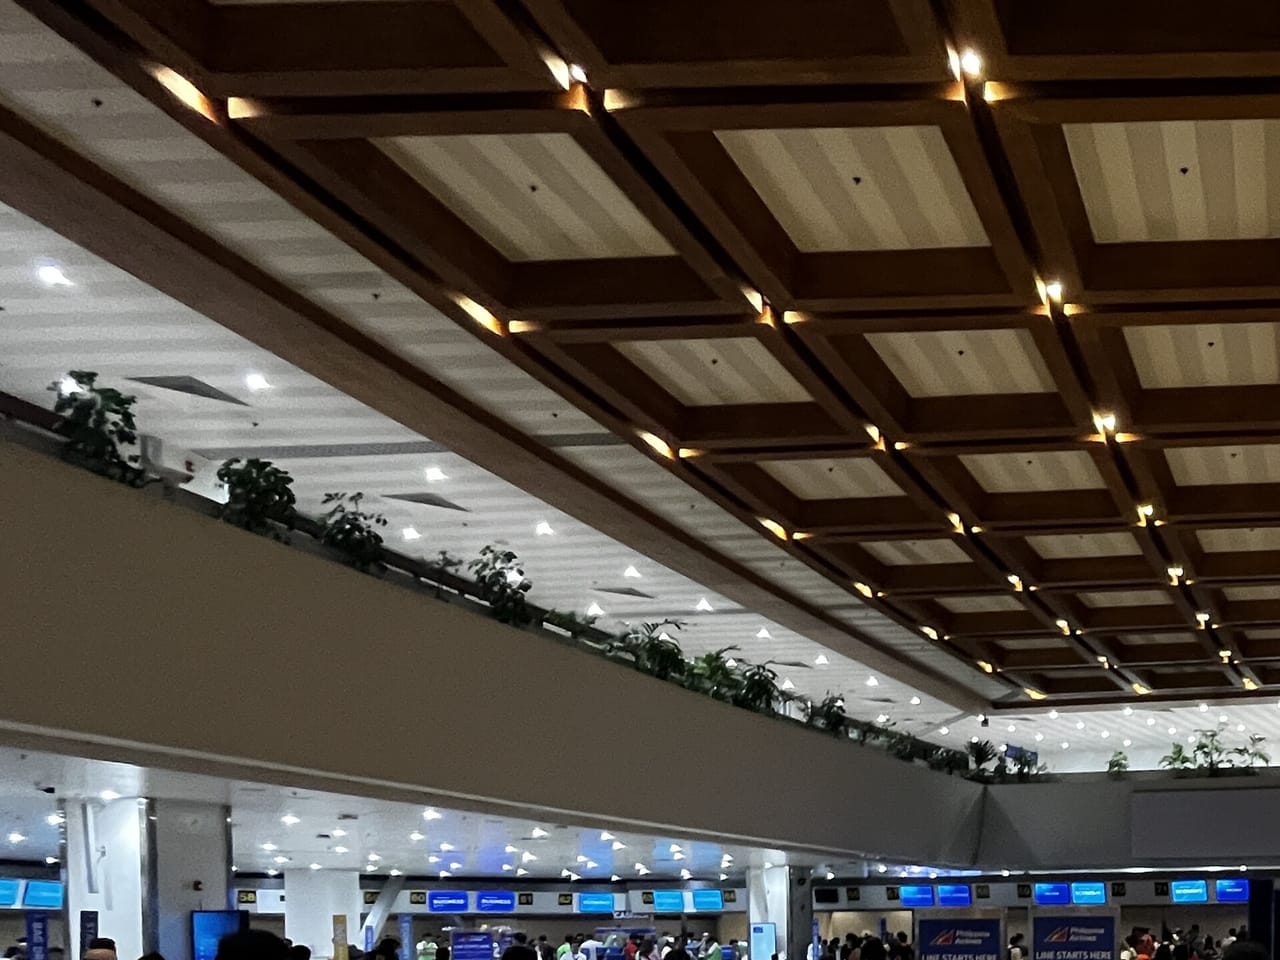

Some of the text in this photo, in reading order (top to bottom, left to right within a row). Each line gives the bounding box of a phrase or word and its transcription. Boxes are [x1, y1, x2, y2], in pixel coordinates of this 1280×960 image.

[239, 892, 256, 901] 58
[1036, 951, 1112, 960] LINE STARTS HERE
